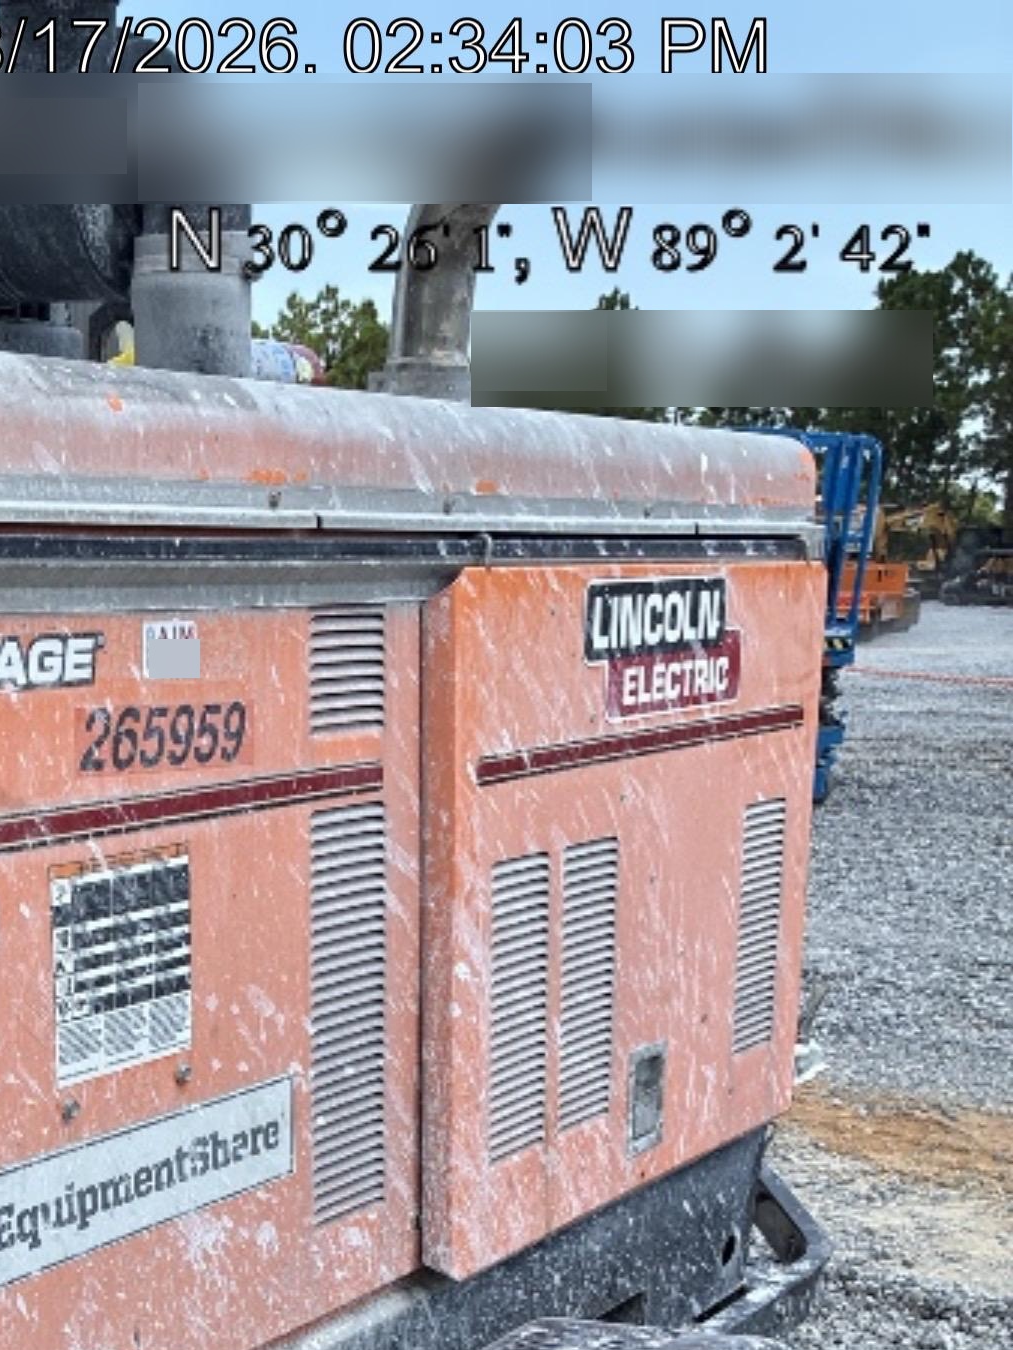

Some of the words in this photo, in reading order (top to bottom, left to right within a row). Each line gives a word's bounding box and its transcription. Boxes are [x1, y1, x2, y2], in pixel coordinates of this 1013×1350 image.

[592, 590, 720, 650] LINCOLN
[622, 656, 729, 706] ELECTRIC
[80, 701, 246, 772] 265959
